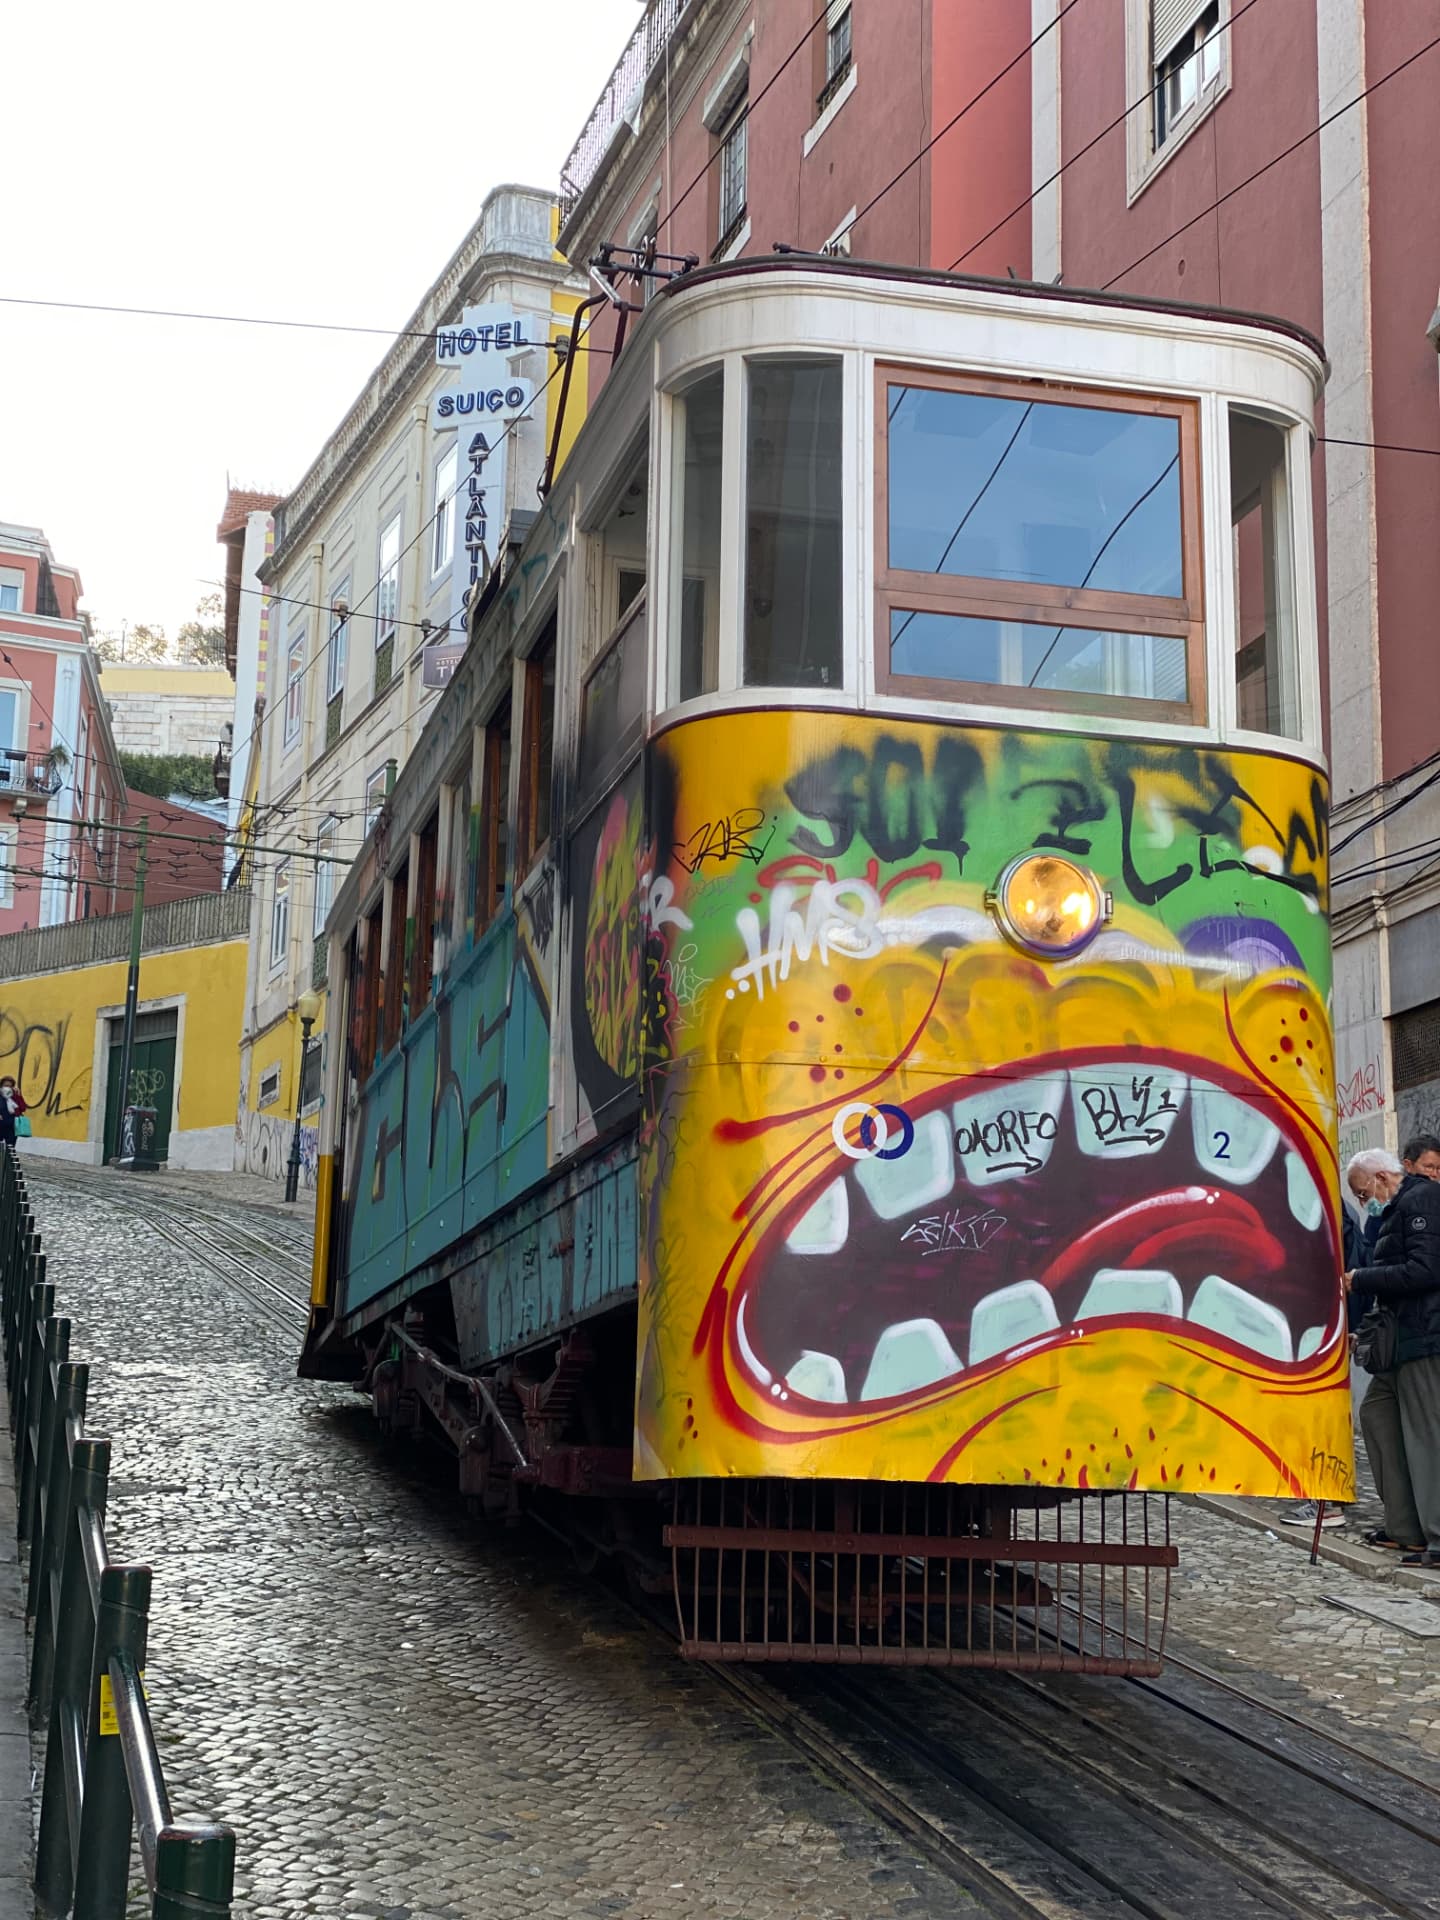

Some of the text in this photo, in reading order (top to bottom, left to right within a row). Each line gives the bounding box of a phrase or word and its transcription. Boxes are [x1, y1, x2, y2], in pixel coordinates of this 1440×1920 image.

[438, 320, 528, 359] HOTEL
[437, 386, 525, 417] SUIÇO
[1213, 1131, 1231, 1159] 2
